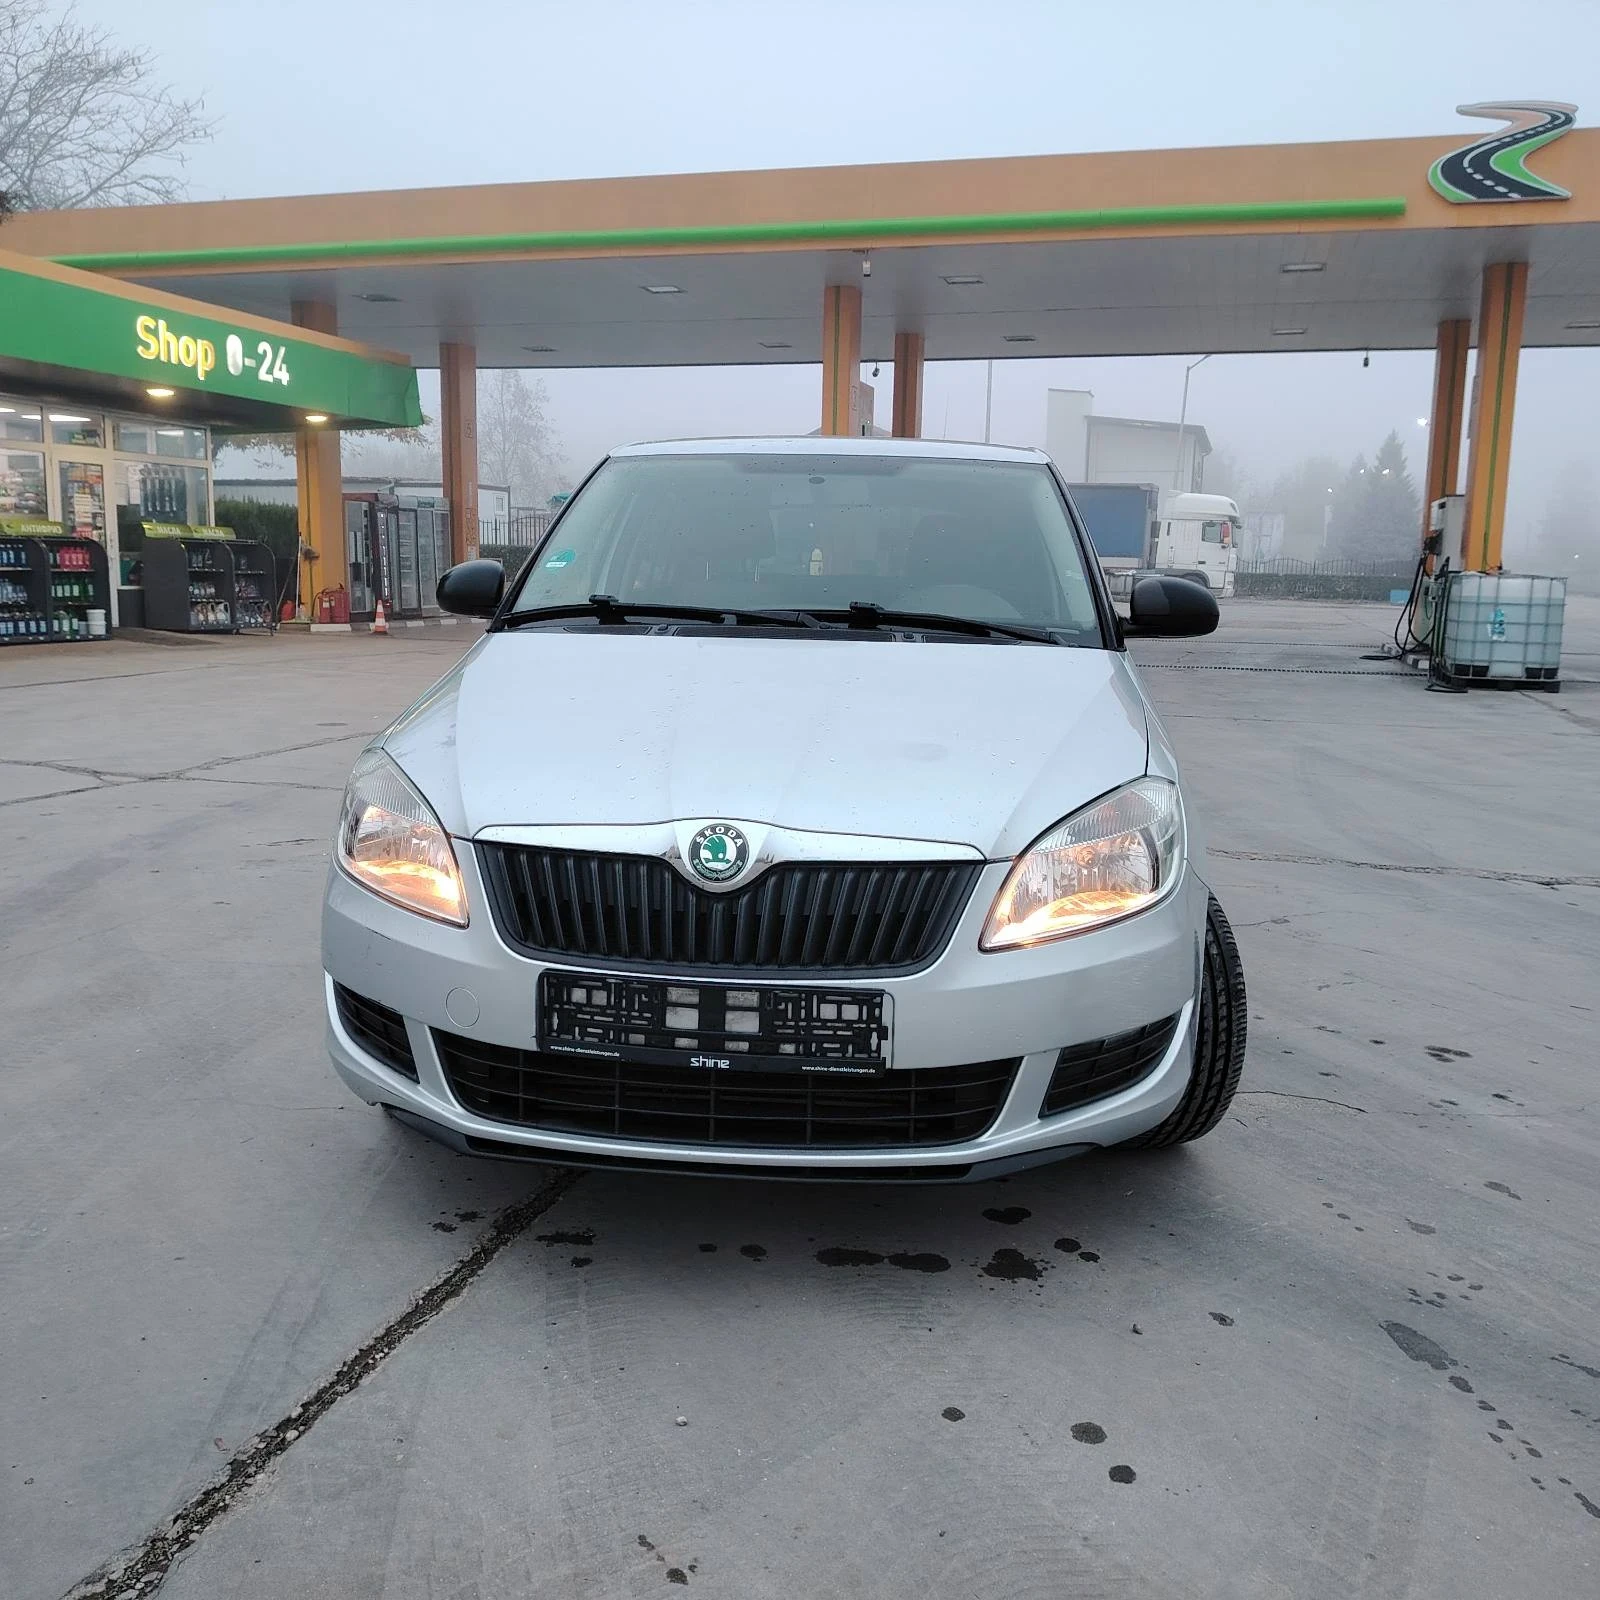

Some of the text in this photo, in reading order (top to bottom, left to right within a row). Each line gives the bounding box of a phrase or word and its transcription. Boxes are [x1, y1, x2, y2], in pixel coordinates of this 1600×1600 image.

[136, 315, 290, 386] Shop 0-24
[690, 1055, 730, 1069] shine
